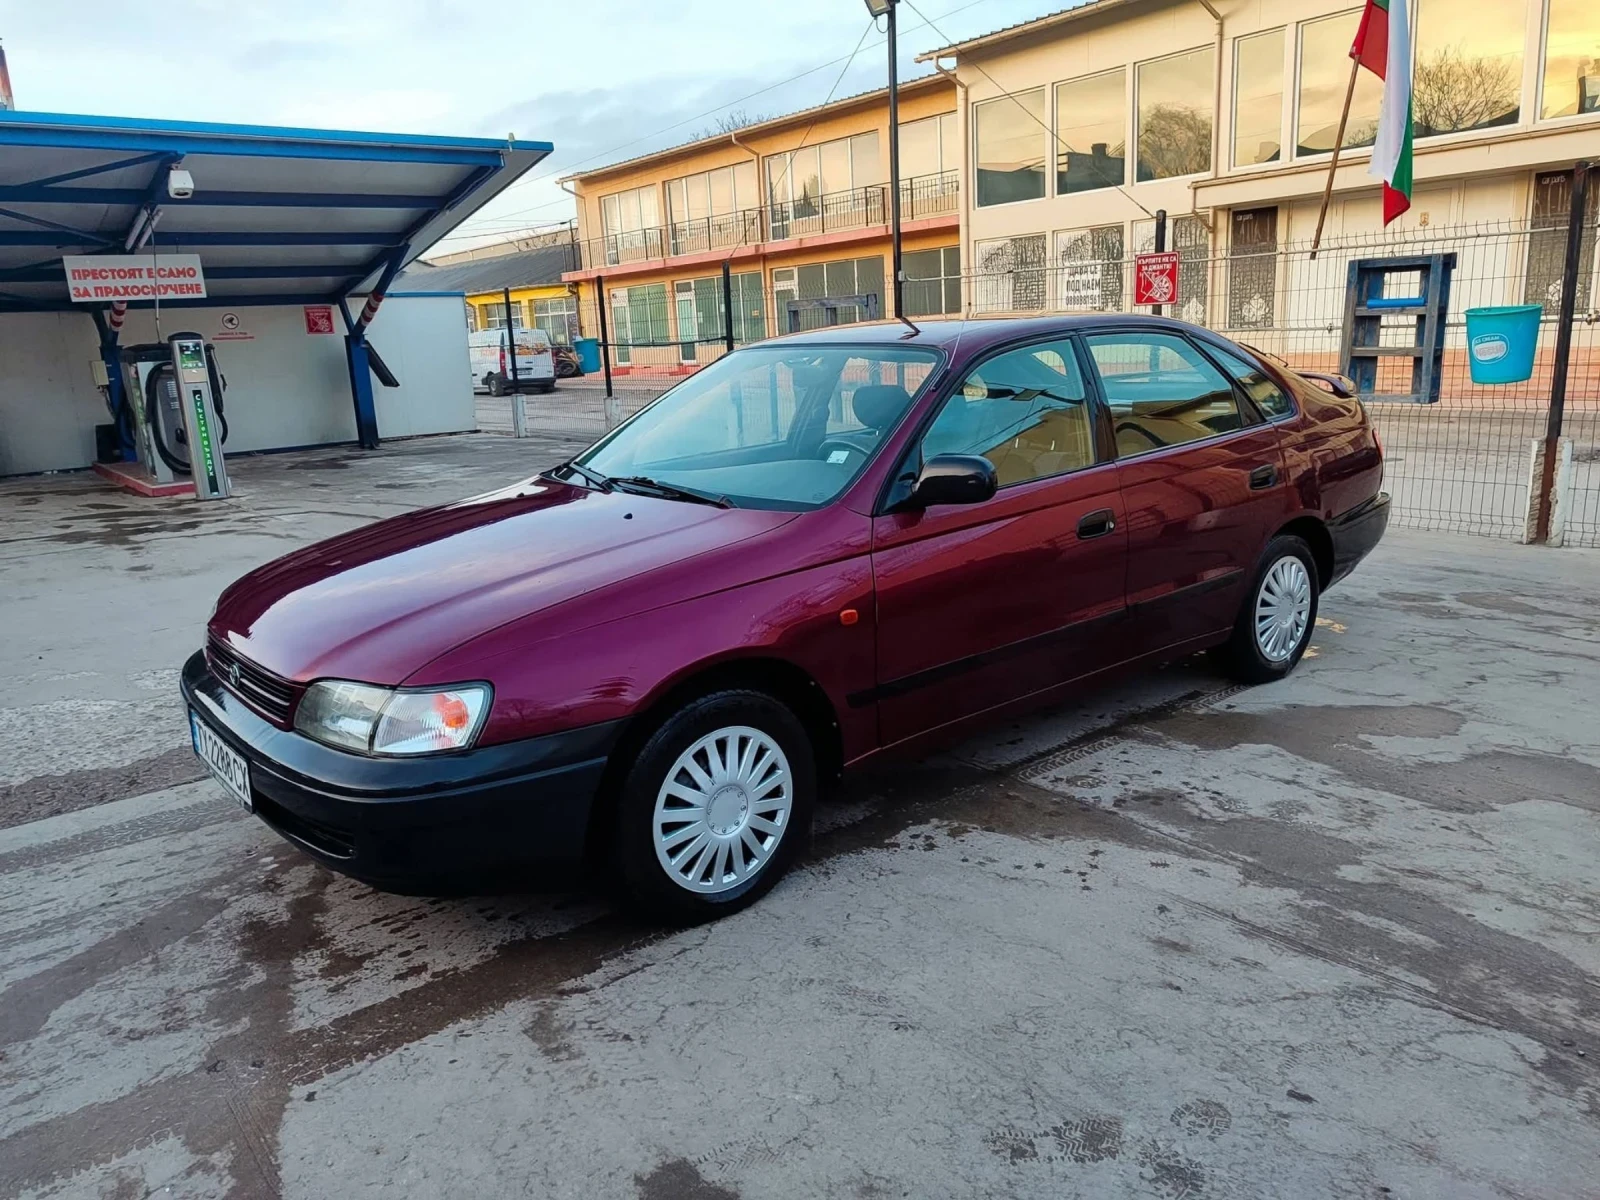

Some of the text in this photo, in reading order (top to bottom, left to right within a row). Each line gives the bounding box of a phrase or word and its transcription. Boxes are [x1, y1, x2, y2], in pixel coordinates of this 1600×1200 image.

[1138, 257, 1161, 265] КЪРПИТЕ
[71, 267, 197, 281] ПРЕСТОЯТ Е САМО
[1090, 264, 1098, 275] СЕ
[73, 283, 203, 298] ЗА ПРАХОСМУЧЕНЕ
[1066, 278, 1101, 293] ПОД НАЕМ
[208, 735, 234, 783] 2288
[233, 757, 251, 800] CX
